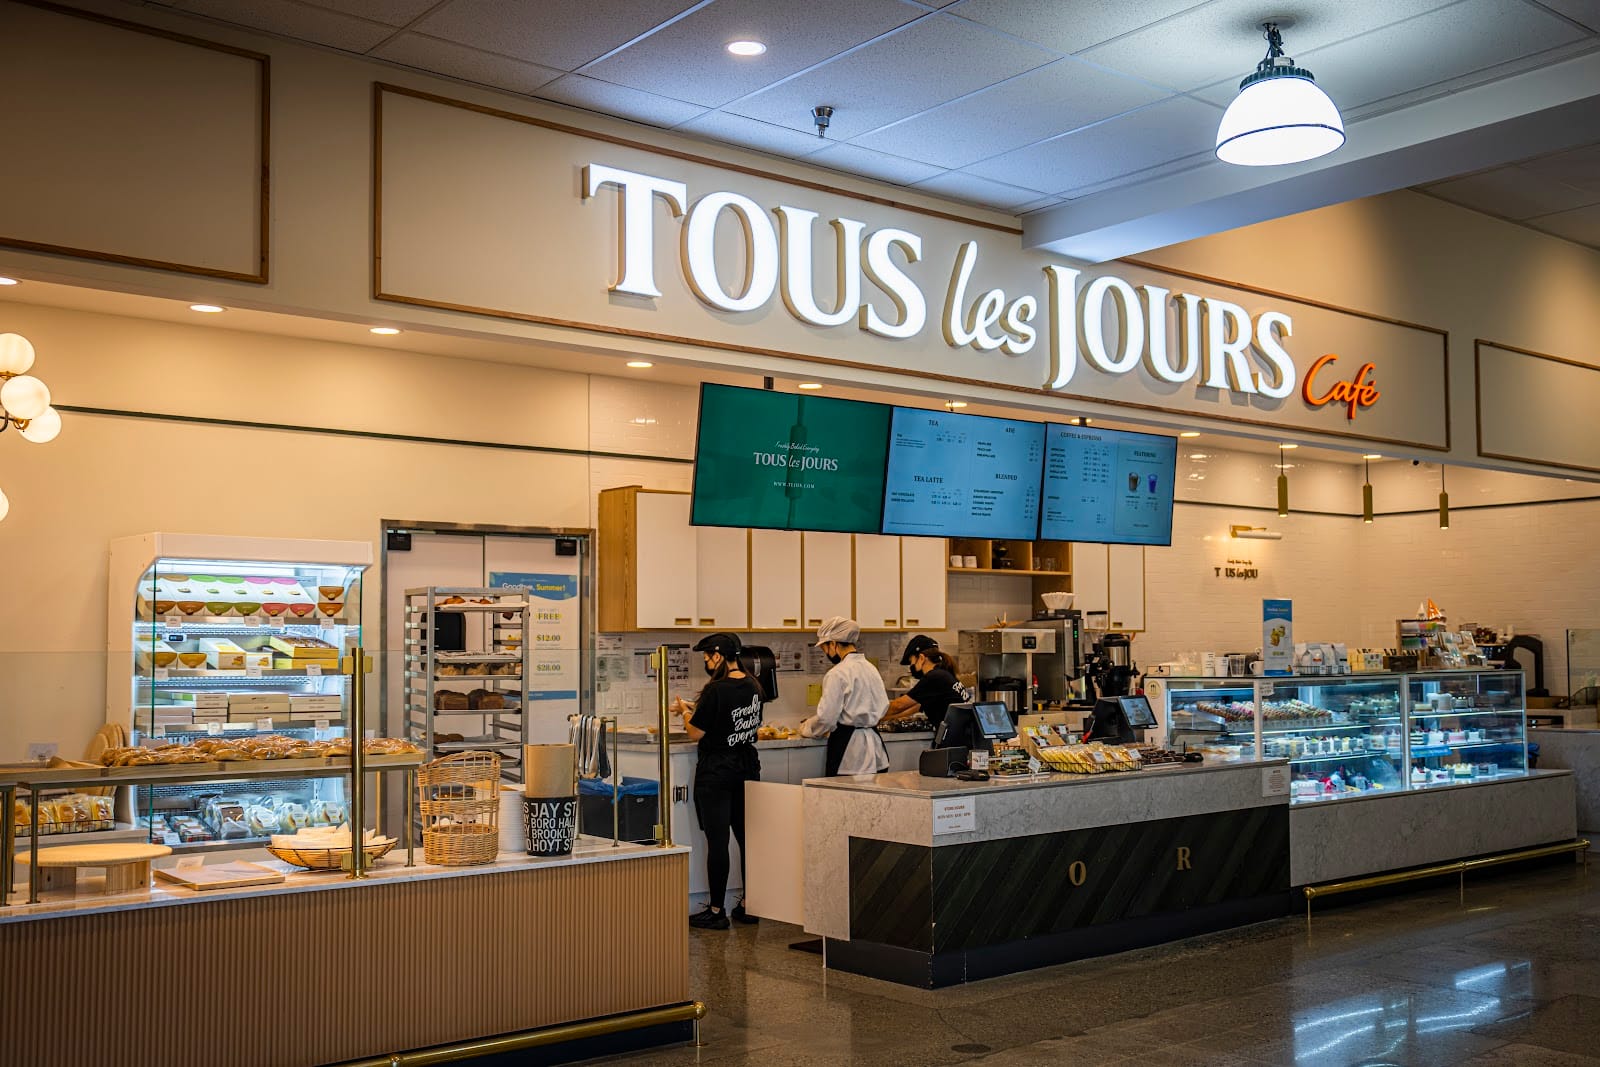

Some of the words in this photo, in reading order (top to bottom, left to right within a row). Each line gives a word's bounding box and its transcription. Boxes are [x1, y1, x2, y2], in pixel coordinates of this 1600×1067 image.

[584, 163, 927, 338] TOUS
[943, 240, 1037, 356] les
[1044, 264, 1297, 400] JOURS
[1302, 353, 1381, 420] Café
[753, 452, 787, 468] TOUS
[788, 455, 801, 468] les
[801, 456, 839, 472] JOURS
[538, 613, 560, 621] FREE
[536, 634, 561, 642] $12.00
[530, 802, 561, 818] JAY
[563, 801, 577, 817] ST
[530, 818, 556, 829] BORO
[532, 839, 562, 852] HOYT
[1176, 846, 1192, 871] R
